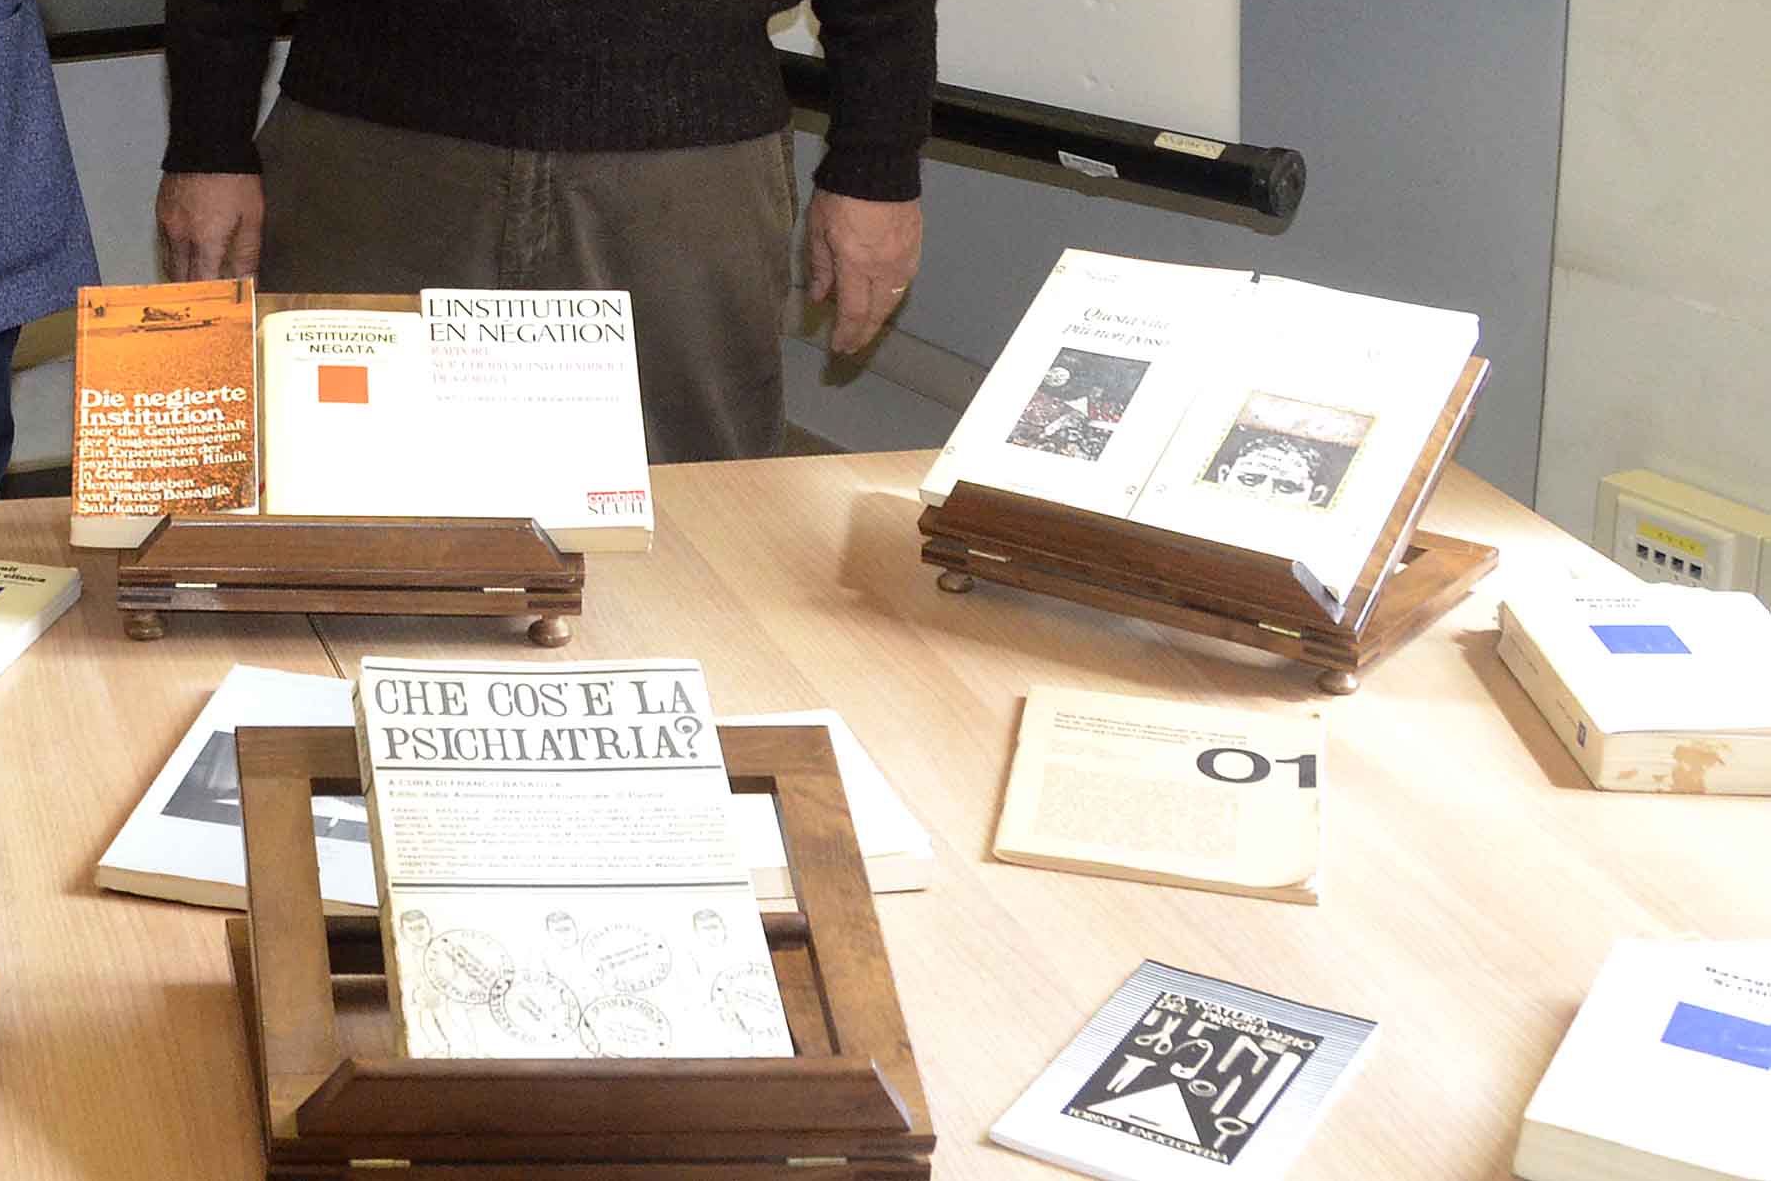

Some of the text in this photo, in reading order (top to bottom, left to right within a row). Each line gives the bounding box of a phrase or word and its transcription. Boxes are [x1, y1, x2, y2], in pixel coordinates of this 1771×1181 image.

[428, 297, 623, 318] L'INSTITUTION
[285, 331, 397, 343] L'ISTITUZIONE
[430, 323, 466, 342] EN
[309, 344, 375, 354] NEGATA
[80, 385, 247, 410] Die negierte
[80, 407, 226, 427] Institution
[79, 420, 247, 437] oder die Gemeinschaft
[79, 431, 241, 449] der Ausgeschlossenen
[79, 442, 224, 462] Ein Experiment der
[79, 451, 247, 472] psychiatrischen Klinik
[97, 467, 133, 480] Görz
[79, 479, 196, 494] Herausgegeben
[79, 484, 231, 503] von Franco Basaglia
[79, 502, 160, 516] Suhrkamp
[3, 573, 46, 583] clinica
[375, 679, 468, 716] CHE
[629, 679, 696, 715] LA
[383, 716, 703, 762] PSICHIATRIA?
[1195, 1000, 1270, 1028] NATURA
[1157, 1000, 1317, 1051] DEL PREGIUDIZIO
